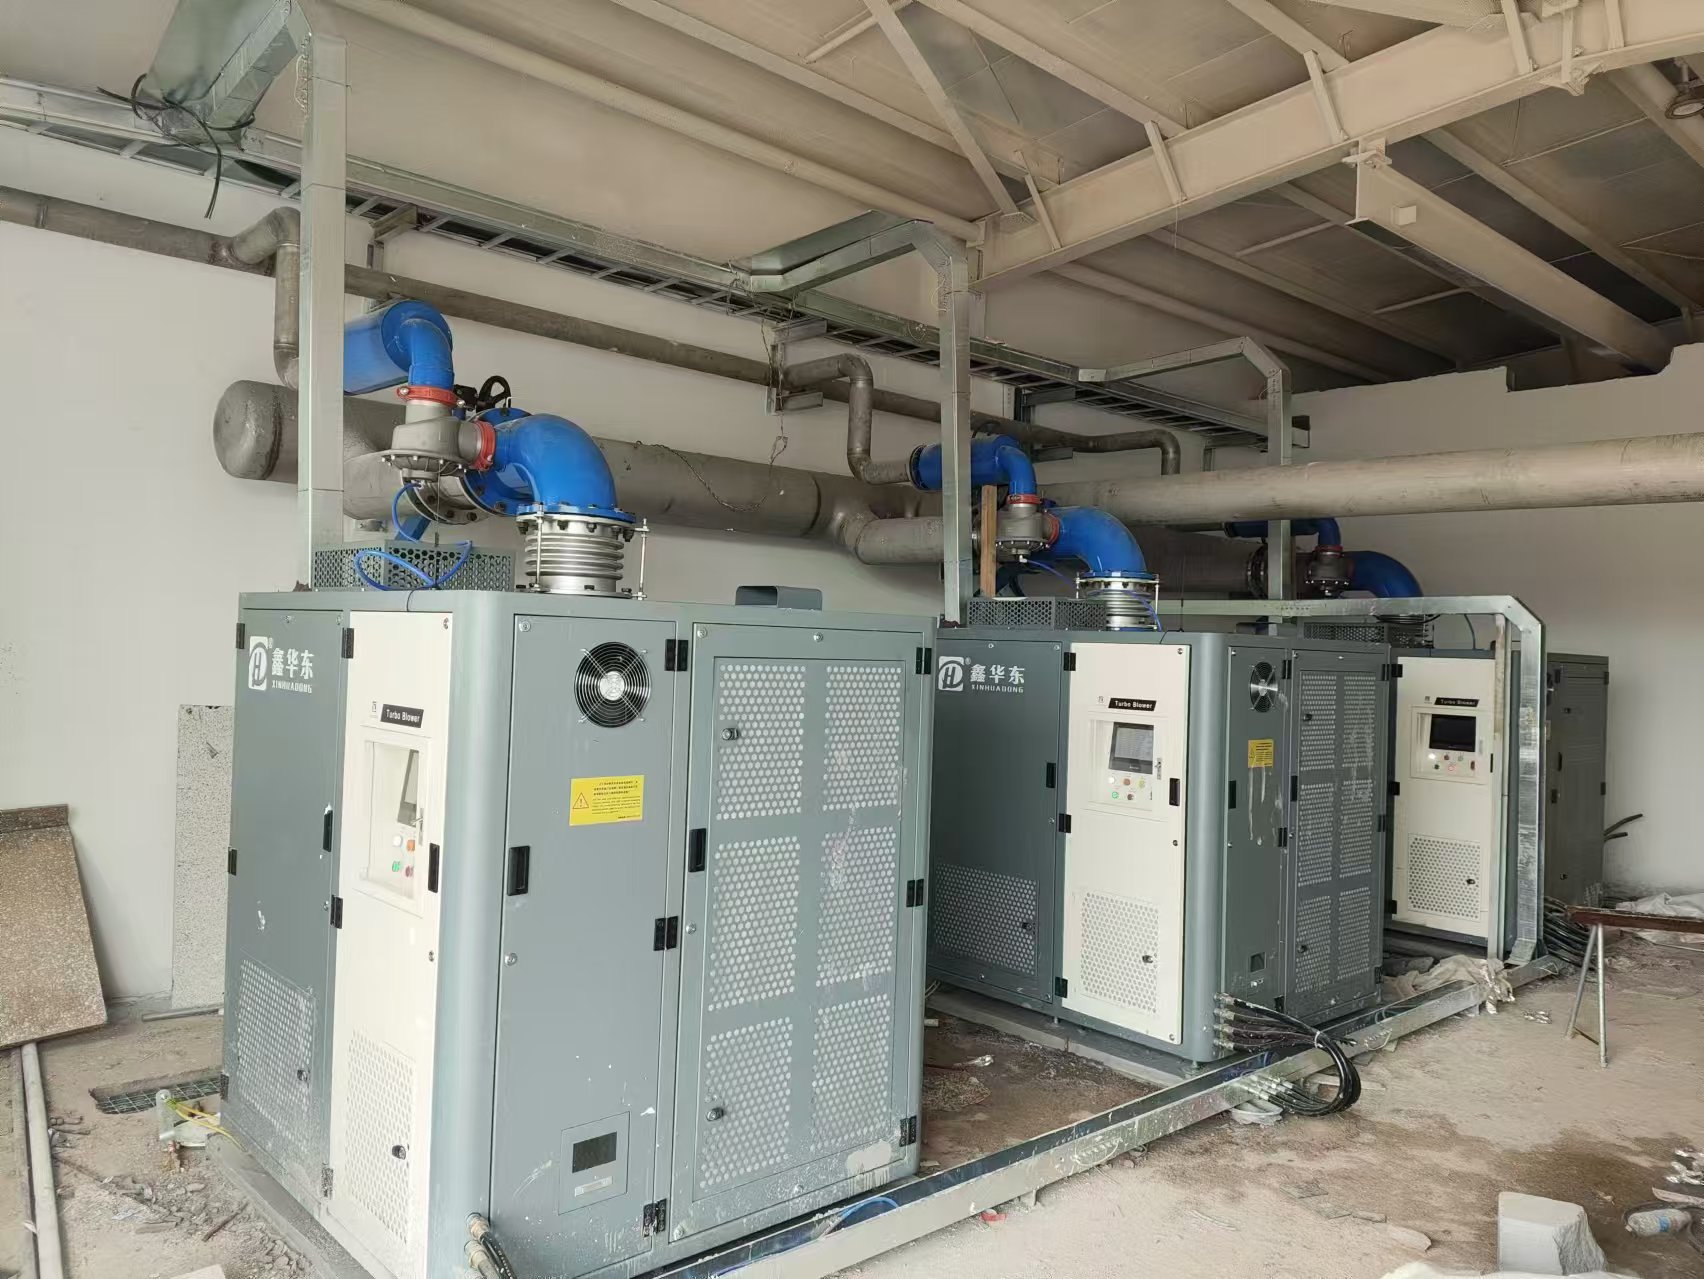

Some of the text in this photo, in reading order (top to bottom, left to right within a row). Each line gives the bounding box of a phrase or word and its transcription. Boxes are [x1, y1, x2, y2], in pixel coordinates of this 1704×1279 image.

[271, 648, 314, 679] 鑫华东
[970, 664, 1025, 684] 鑫华东
[272, 680, 313, 694] XINHUADONG
[971, 684, 1024, 693] XINHUADONG
[1132, 701, 1153, 709] Blower
[386, 709, 420, 723] Turbo Blower
